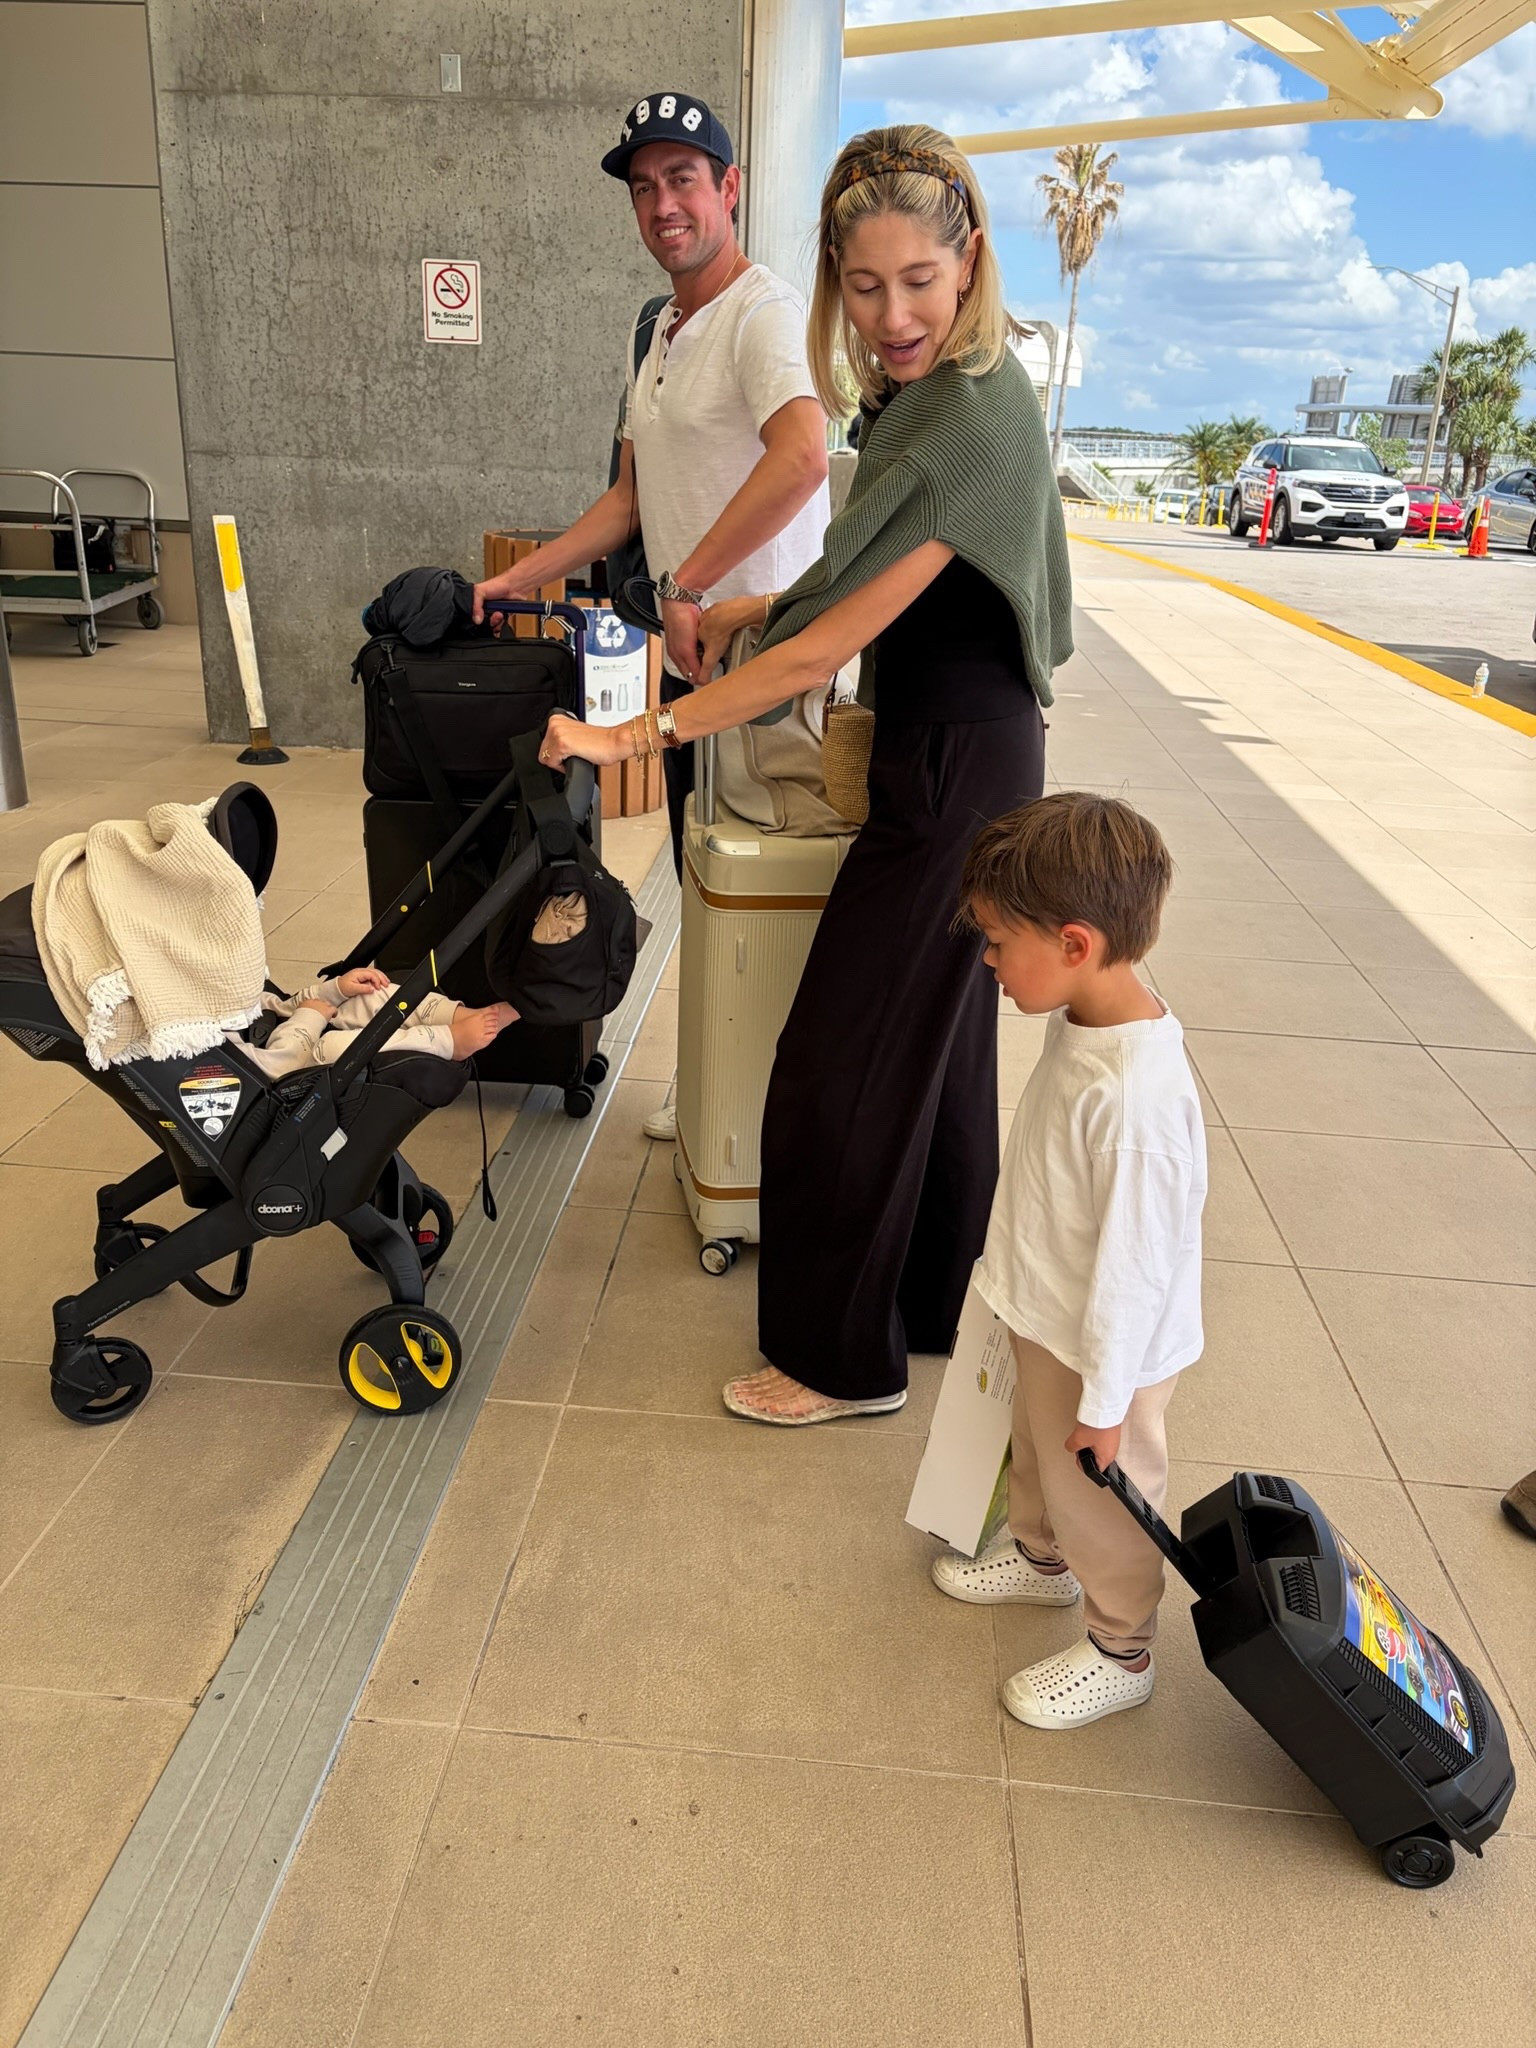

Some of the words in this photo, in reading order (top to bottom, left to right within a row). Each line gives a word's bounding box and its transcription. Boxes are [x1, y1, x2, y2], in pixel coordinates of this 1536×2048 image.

[622, 95, 702, 142] 1988
[443, 311, 474, 321] Smoking
[435, 318, 470, 327] Permitted
